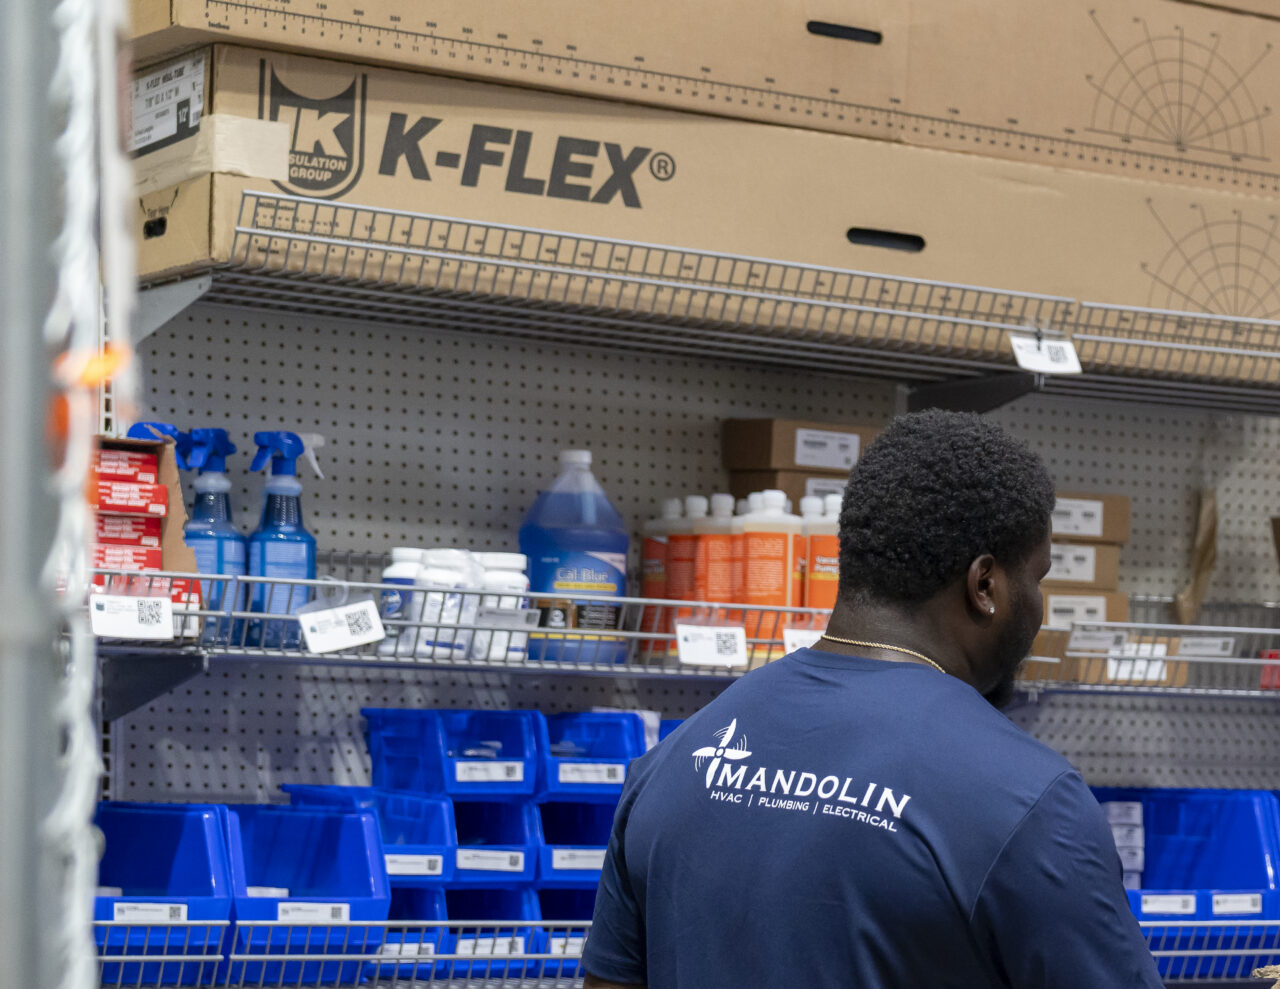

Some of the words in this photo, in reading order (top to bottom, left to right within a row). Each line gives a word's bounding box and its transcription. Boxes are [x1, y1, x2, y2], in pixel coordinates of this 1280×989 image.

[288, 154, 348, 172] SULATION
[290, 166, 332, 181] GROUP
[716, 763, 911, 819] MANDOLIN
[710, 790, 743, 804] HVAC
[758, 796, 810, 812] PLUMBING
[822, 804, 898, 833] ELECTRICAL
